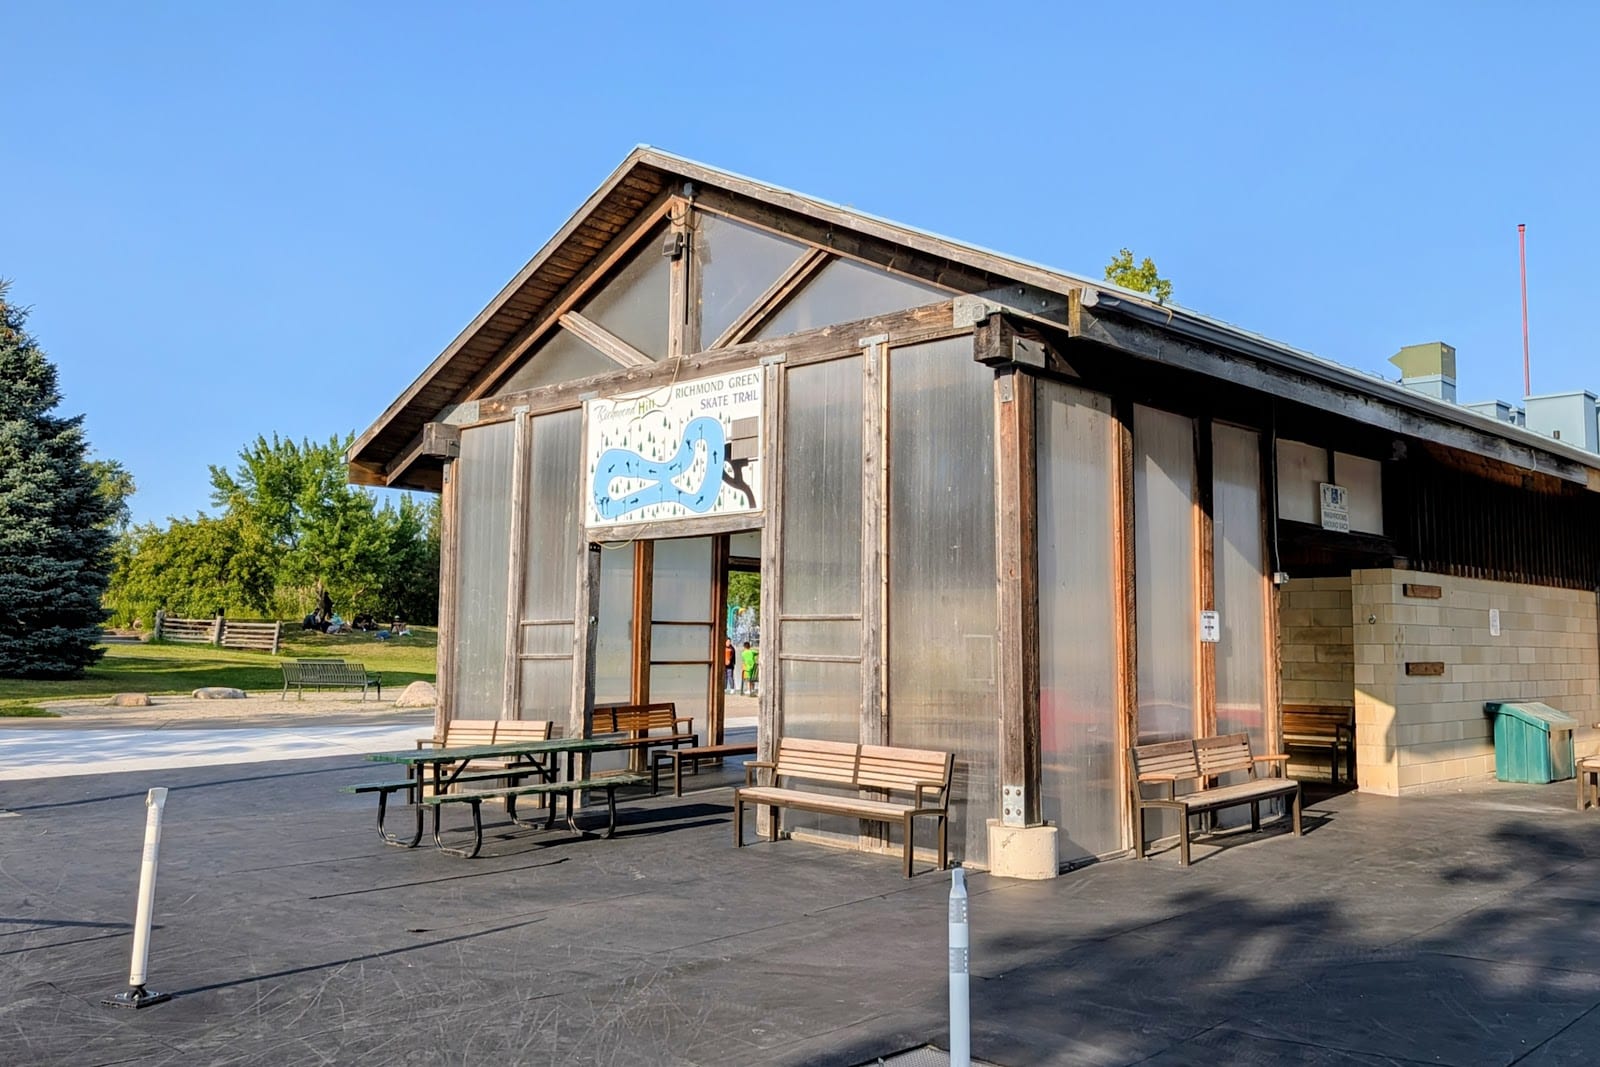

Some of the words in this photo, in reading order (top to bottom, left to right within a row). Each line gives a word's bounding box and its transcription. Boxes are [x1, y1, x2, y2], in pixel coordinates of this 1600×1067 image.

[675, 380, 724, 399] RICHMOND
[729, 373, 760, 388] GREEN
[638, 399, 655, 415] Hill
[700, 395, 728, 410] SKATE
[733, 389, 759, 404] TRAIL
